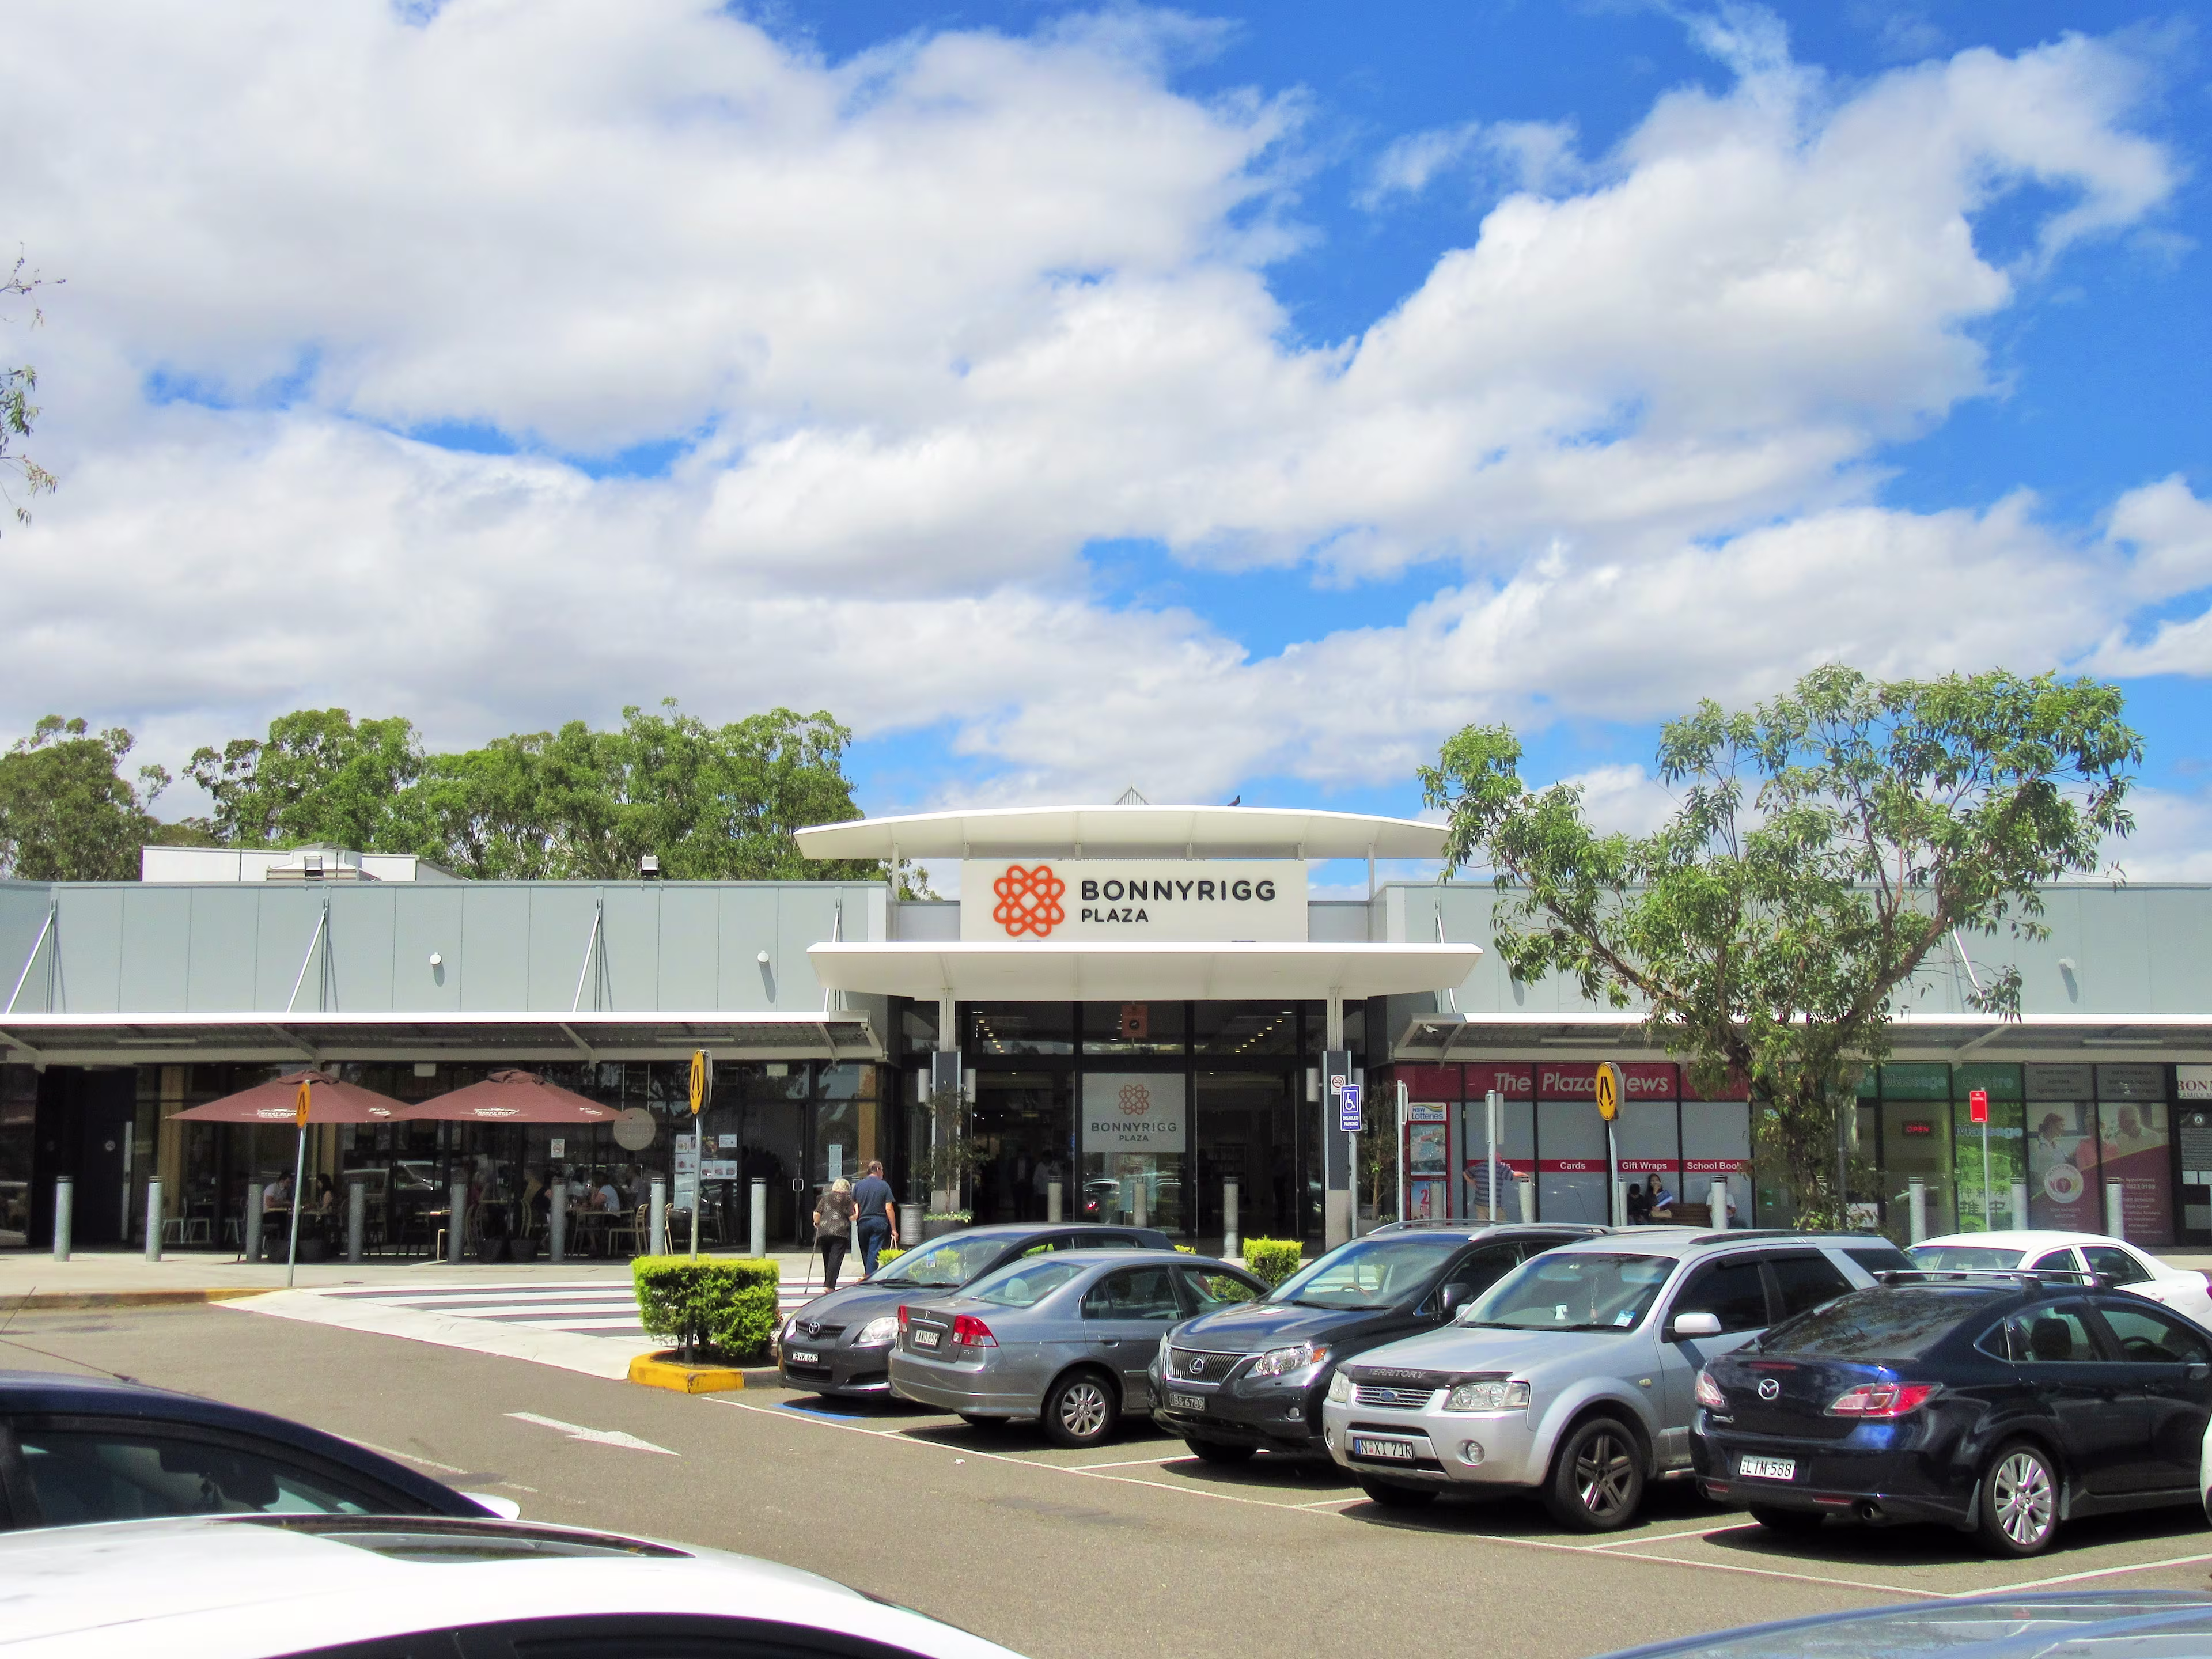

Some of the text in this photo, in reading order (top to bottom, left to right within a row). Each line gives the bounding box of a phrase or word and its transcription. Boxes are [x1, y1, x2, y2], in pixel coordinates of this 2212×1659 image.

[1081, 880, 1275, 902] BONNYRIGG
[1082, 908, 1149, 923] PLAZA
[1494, 1073, 1531, 1091] The
[1623, 1073, 1668, 1092] ews
[1883, 1073, 1947, 1089] Massage
[1092, 1123, 1177, 1132] BONNYRIGG
[1906, 1125, 1930, 1133] OPEN
[1955, 1125, 2024, 1139] Massage
[1560, 1161, 1586, 1169] Cards
[1622, 1161, 1667, 1171] Gift Wraps
[1687, 1161, 1717, 1169] School
[1368, 1368, 1426, 1378] TERRITORY
